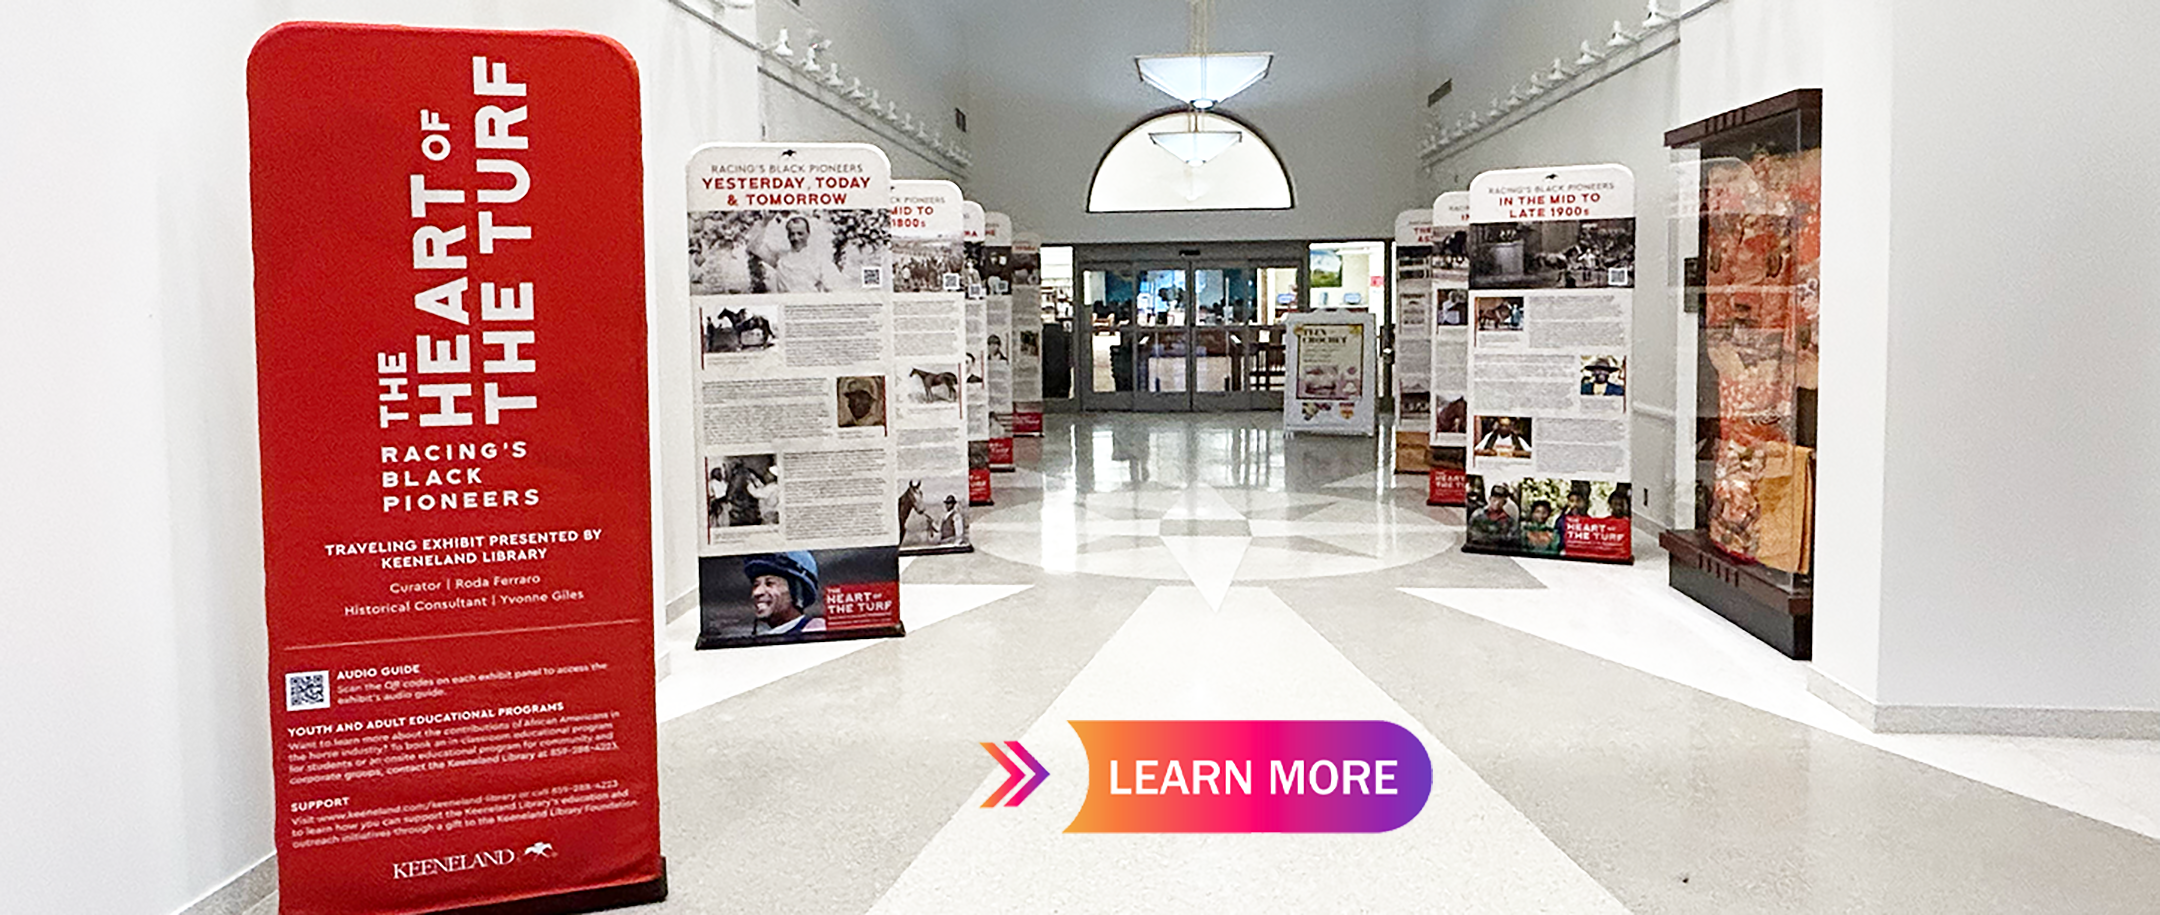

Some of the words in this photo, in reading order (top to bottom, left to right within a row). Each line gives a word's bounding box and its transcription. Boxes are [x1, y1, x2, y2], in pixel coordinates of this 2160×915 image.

[420, 109, 450, 160] OF
[472, 56, 532, 254] TURF
[712, 164, 766, 174] RACING'S
[770, 164, 805, 174] BLACK
[810, 164, 863, 172] PIONEERS
[816, 176, 871, 188] TODAY
[1568, 182, 1615, 190] PIONEERS
[727, 194, 738, 206] &
[746, 194, 847, 206] TOMORROW
[1500, 197, 1513, 206] IN
[1518, 196, 1546, 205] THE
[1550, 194, 1576, 204] MID
[1581, 193, 1600, 202] TO
[917, 206, 934, 216] TO
[1510, 208, 1545, 218] LATE
[1550, 206, 1590, 217] 1900s
[891, 218, 926, 228] 1800s
[410, 174, 473, 427] HEART
[480, 282, 538, 424] THE
[378, 351, 408, 428] THE
[381, 441, 528, 463] RACING'S
[382, 467, 483, 488] BLACK
[383, 488, 540, 513] PIONEERS
[1567, 523, 1606, 532] HEART
[324, 540, 418, 556] TRAVELING
[422, 536, 486, 550] EXHIBIT
[489, 531, 578, 547] PRESENTED
[584, 529, 602, 541] BY
[1567, 532, 1590, 540] THE
[1593, 533, 1625, 542] TURF
[382, 552, 478, 569] KEENELAND
[482, 548, 548, 563] LIBRARY
[390, 582, 442, 594] Curator
[455, 577, 490, 590] Roda
[494, 575, 540, 586] Ferraro
[344, 601, 410, 616] Historical
[414, 597, 488, 611] Consultant
[500, 592, 548, 604] Yvonne
[552, 589, 584, 601] Giles
[827, 592, 872, 604] HEART
[828, 604, 854, 614] THE
[857, 600, 892, 612] TURF
[336, 668, 378, 680] AUDIO
[380, 664, 420, 677] GUIDE
[365, 682, 382, 691] the
[403, 678, 434, 688] codes
[436, 676, 450, 686] on
[452, 674, 476, 684] each
[478, 670, 512, 682] exhibit
[514, 668, 542, 680] panel
[544, 667, 555, 676] to
[557, 664, 589, 674] access
[384, 688, 413, 700] audio
[288, 724, 332, 738] YOUTH
[336, 721, 364, 732] AND
[366, 716, 406, 730] ADULT
[409, 708, 496, 726] EDUCATIONAL
[498, 702, 564, 716] PROGRAMS
[290, 796, 350, 812] SUPPORT
[392, 848, 516, 880] KEENELAND
